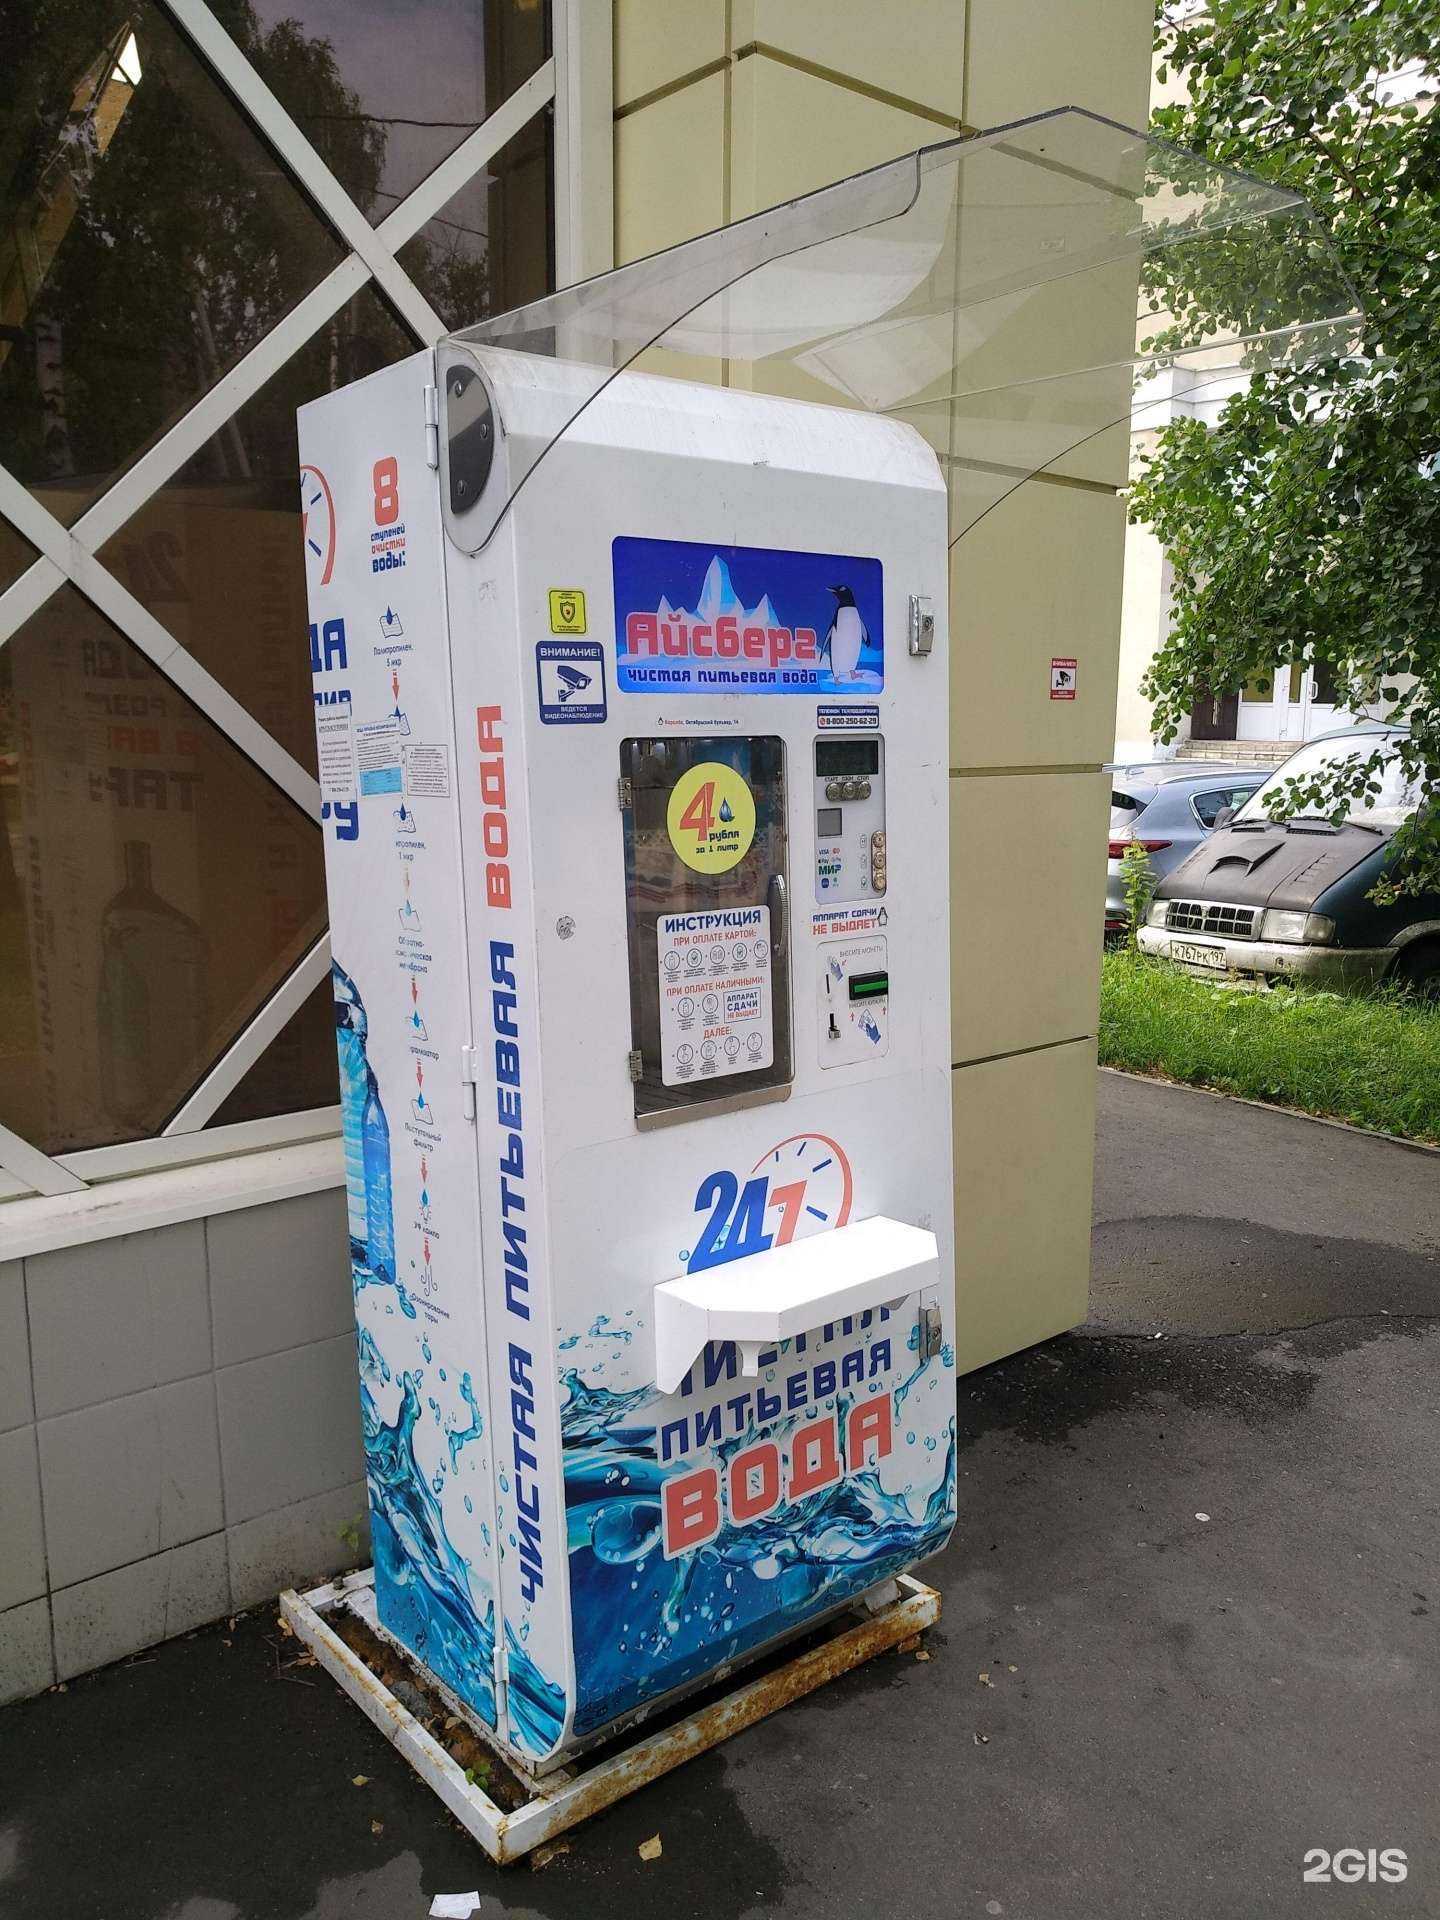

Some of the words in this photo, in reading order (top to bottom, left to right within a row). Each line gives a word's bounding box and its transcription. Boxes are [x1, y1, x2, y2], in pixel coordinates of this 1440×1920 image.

[373, 456, 399, 526] 8
[370, 522, 406, 542] ступеней
[371, 536, 406, 554] очистки
[372, 550, 406, 573] воды:
[626, 612, 817, 668] Айсберг
[540, 647, 600, 657] ВНИМАНИЕ!
[627, 668, 691, 683] чистая
[698, 668, 777, 684] питьевая
[783, 670, 818, 684] вода
[544, 712, 604, 720] ВИДЕОНАБЛЮДЕНИЕ
[476, 705, 513, 910] ВОДА
[680, 782, 715, 841] 4
[709, 829, 740, 842] рубля
[716, 843, 739, 854] литр
[818, 864, 842, 875] МИР
[665, 910, 761, 933] ИНСТРУКЦИЯ
[813, 911, 849, 922] АППАРАТ
[851, 908, 877, 918] СДАЧИ
[813, 923, 828, 935] НЕ
[832, 918, 877, 933] ВЫДАЕТ
[673, 937, 690, 946] ПРИ
[692, 933, 722, 944] ОПЛАТЕ
[666, 987, 683, 997] ПРИ
[684, 982, 713, 994] ОПЛАТЕ
[727, 991, 758, 1003] АППАРАТ
[727, 1000, 758, 1012] СДАЧИ
[703, 1027, 732, 1040] ДАЛЕЕ:
[490, 939, 530, 1322] ПИТЬЕВАЯ
[661, 1338, 892, 1463] ПИТЬЕВАЯ
[508, 1342, 545, 1603] ЧИСТАЯ
[666, 1393, 892, 1554] ВОДА
